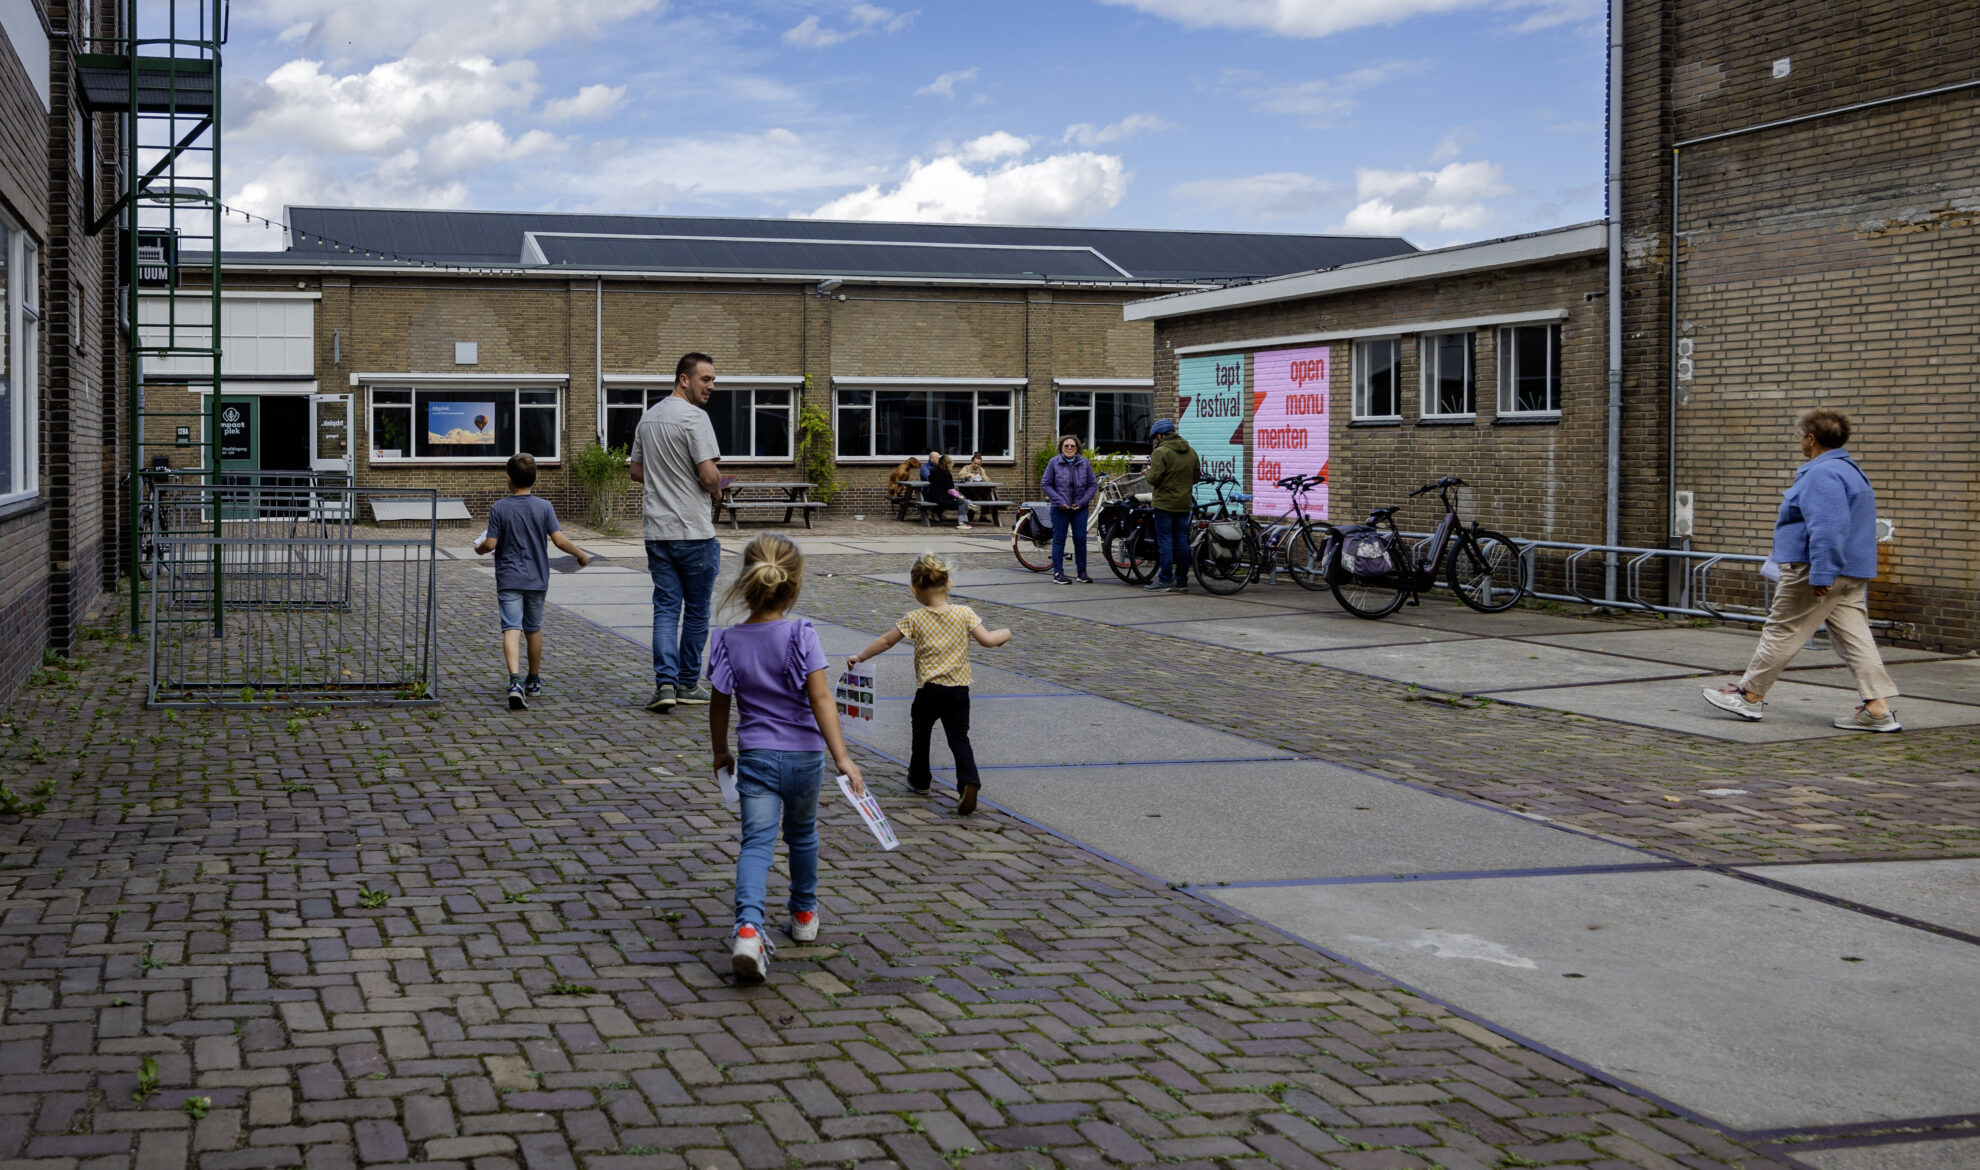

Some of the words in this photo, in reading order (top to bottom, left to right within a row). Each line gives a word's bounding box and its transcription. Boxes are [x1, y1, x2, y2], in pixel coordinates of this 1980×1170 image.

[1215, 360, 1241, 391] tapt
[1290, 358, 1324, 388] open
[1196, 391, 1241, 418] festival
[1285, 393, 1324, 416] monu
[220, 421, 245, 429] mpact
[223, 427, 241, 436] plek
[1257, 424, 1308, 450] menten
[1257, 455, 1281, 489] dag
